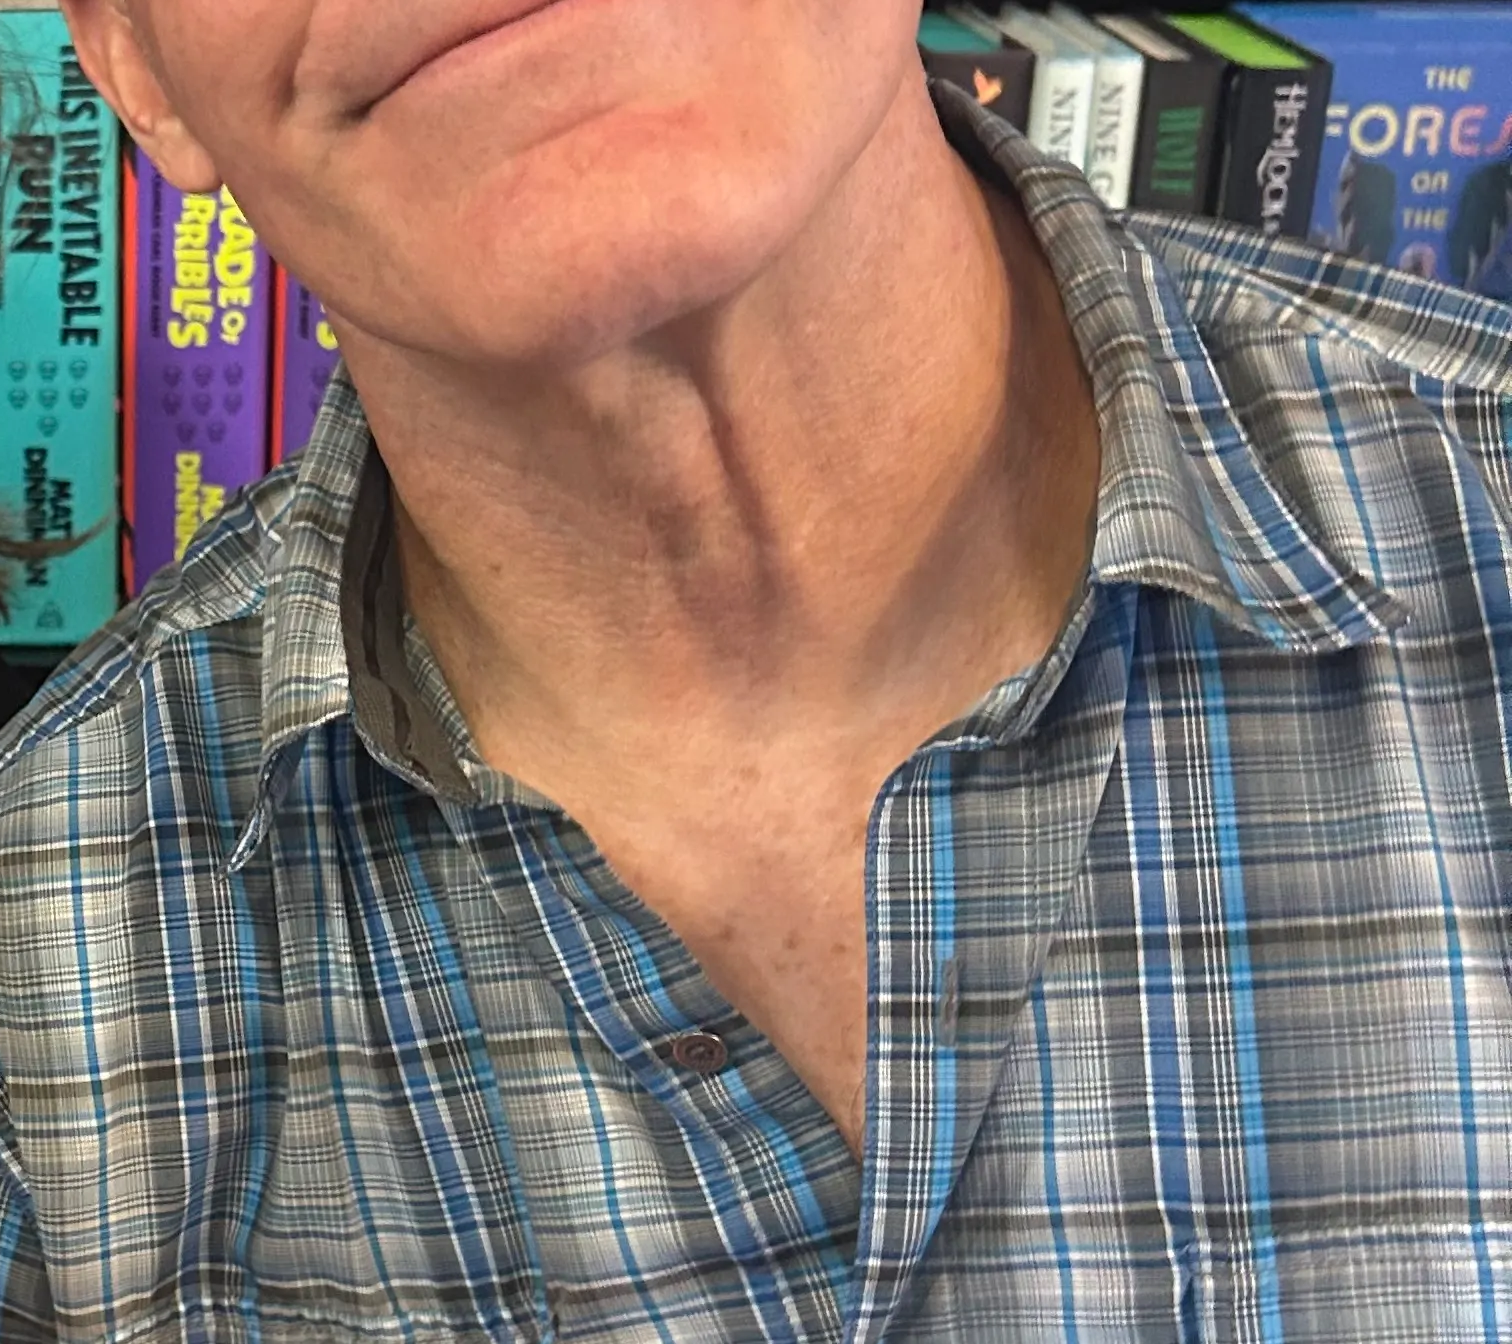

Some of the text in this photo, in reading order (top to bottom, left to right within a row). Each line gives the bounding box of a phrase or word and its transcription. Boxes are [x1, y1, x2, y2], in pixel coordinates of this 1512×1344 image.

[1425, 66, 1473, 90] THE
[1048, 86, 1078, 161] NINE
[1094, 82, 1125, 162] NINE
[9, 134, 57, 255] RUIN
[1402, 208, 1449, 230] THE
[58, 130, 104, 347] INEVITABLE
[167, 193, 216, 349] RRIBLES
[49, 478, 73, 541] MAT
